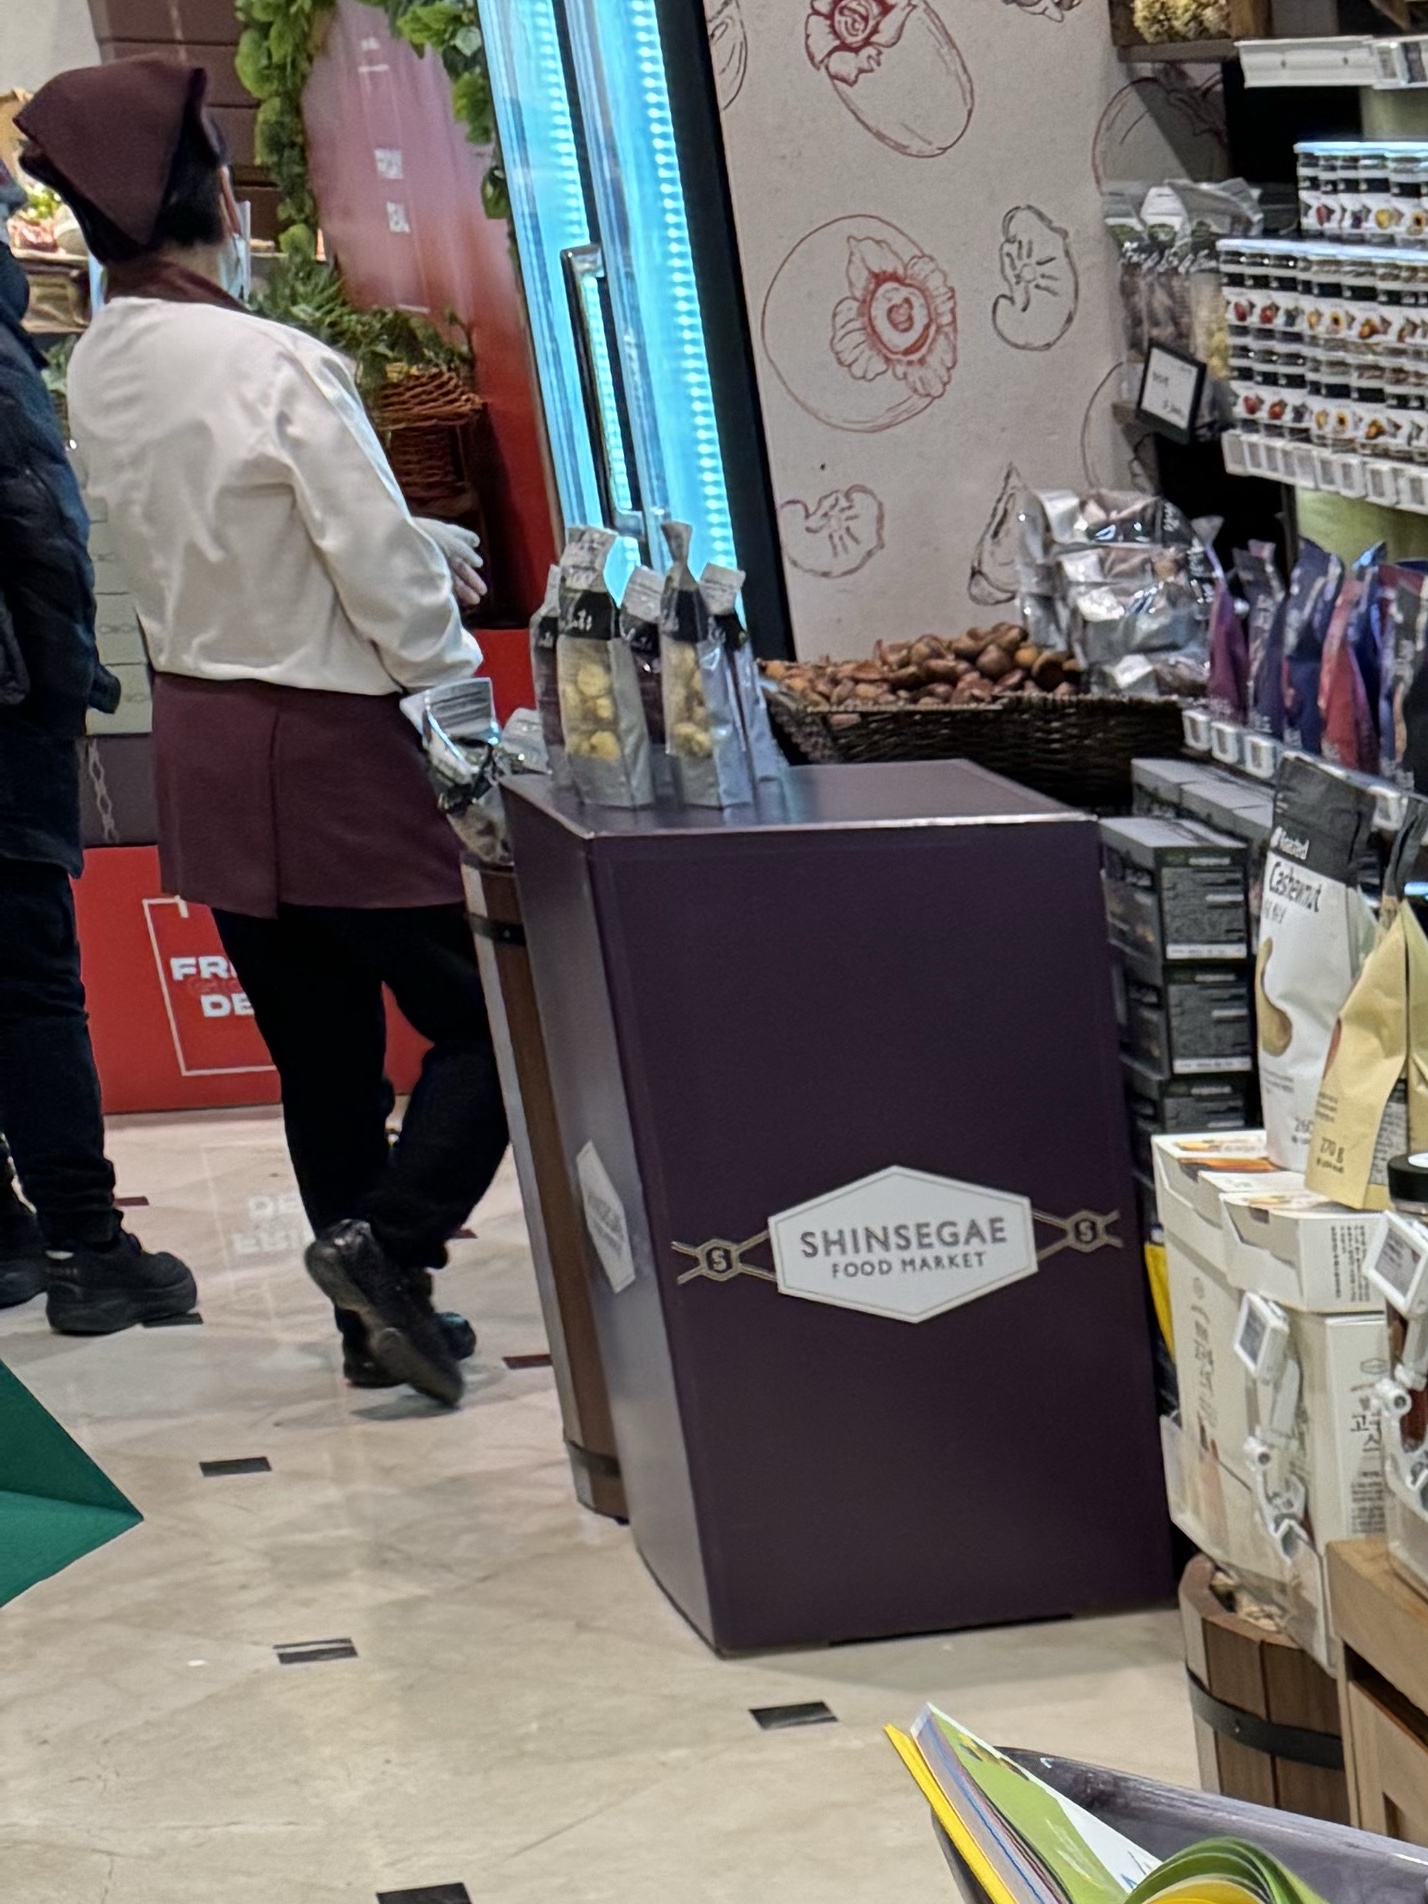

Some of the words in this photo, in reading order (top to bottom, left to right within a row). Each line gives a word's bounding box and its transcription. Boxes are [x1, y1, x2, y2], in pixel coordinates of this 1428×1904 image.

[170, 956, 238, 981] FR
[800, 1216, 1009, 1259] SHINSEGAE
[831, 1256, 893, 1280] FOOD
[901, 1251, 988, 1274] MARKET
